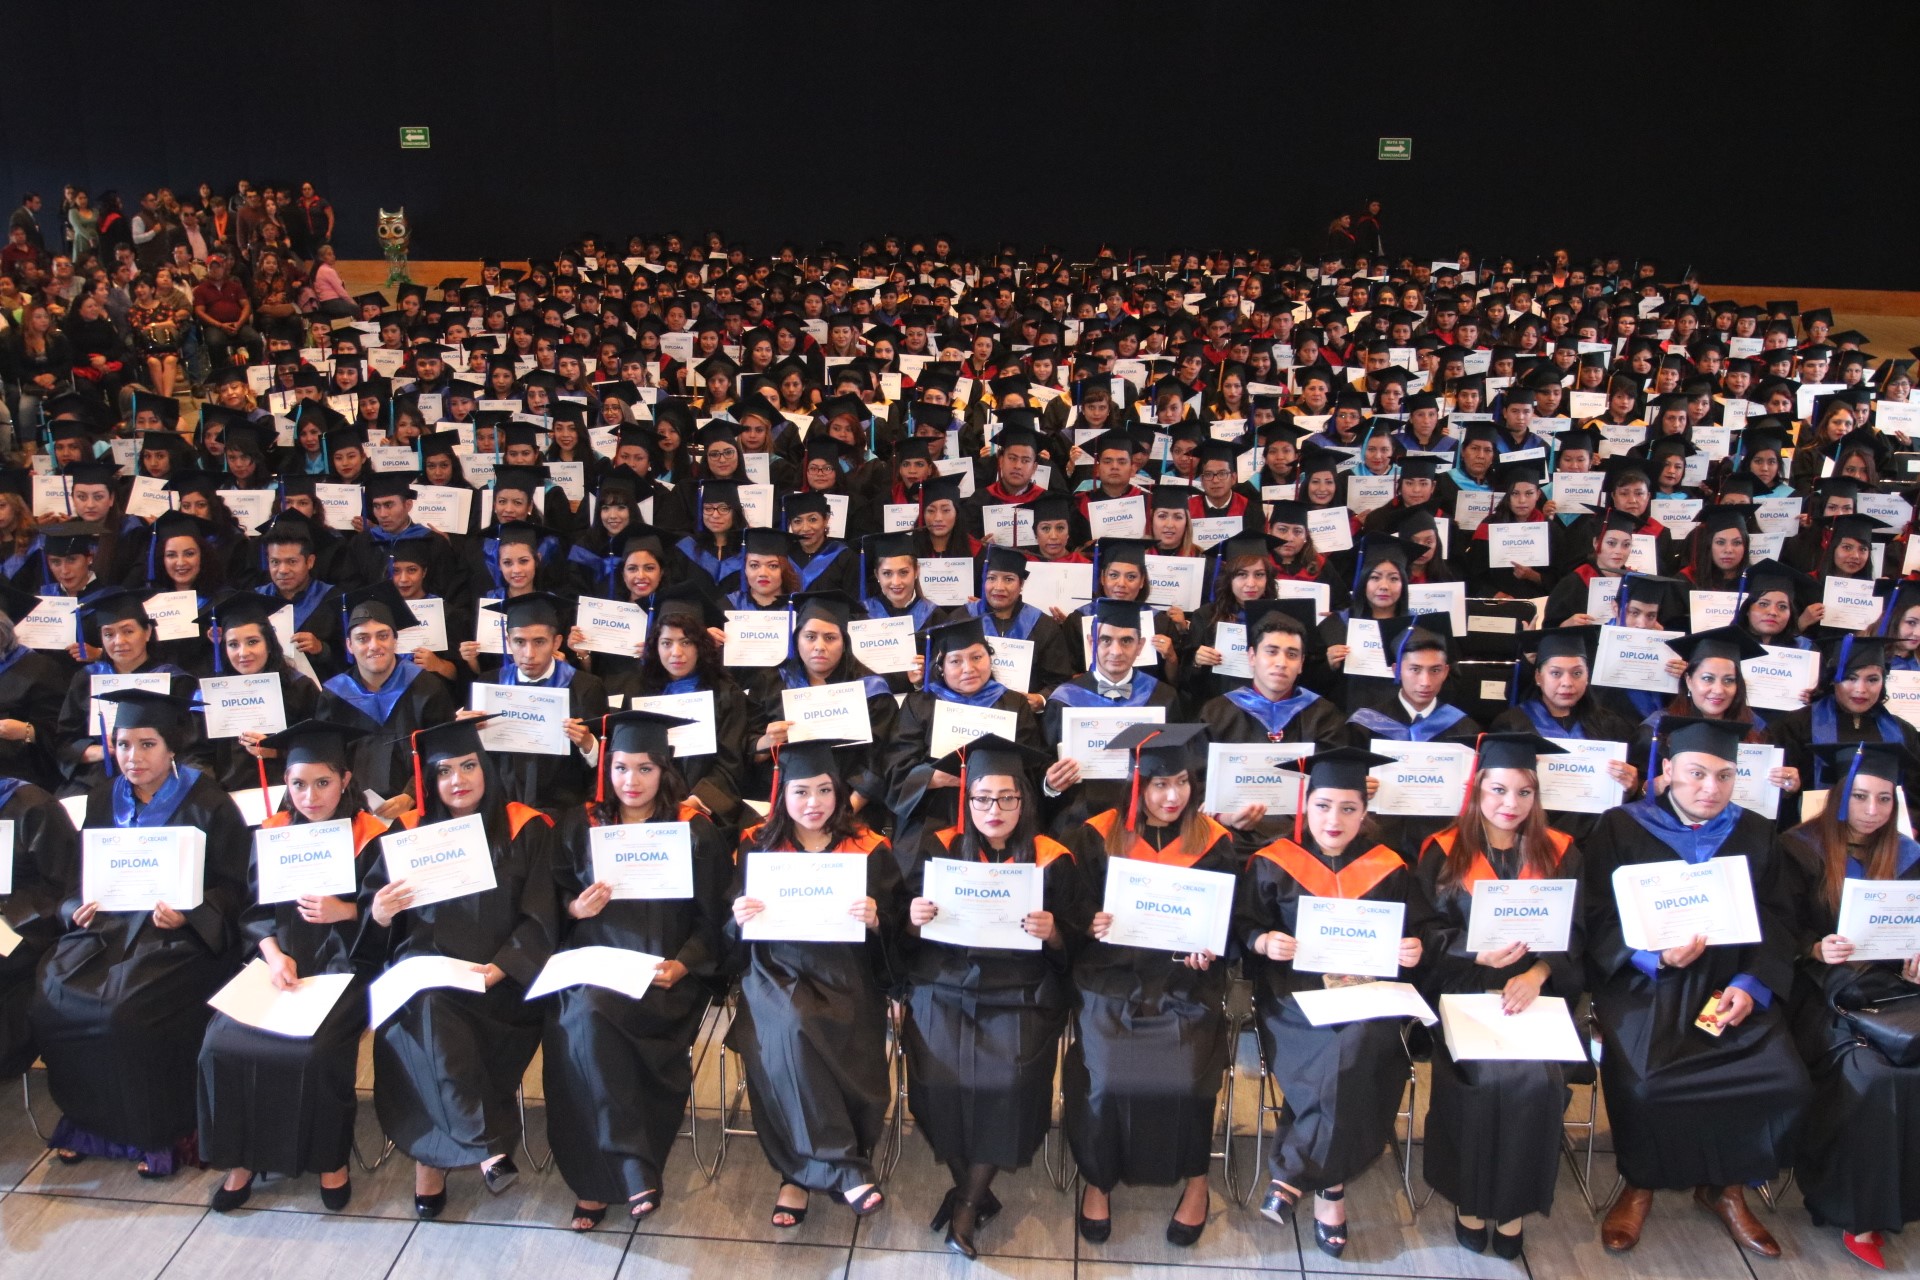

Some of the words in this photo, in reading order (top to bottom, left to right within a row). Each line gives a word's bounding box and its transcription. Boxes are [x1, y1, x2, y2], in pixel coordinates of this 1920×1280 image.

[1838, 596, 1873, 606] DIPLOMA
[740, 631, 780, 640] DIPLOMA
[860, 638, 899, 648] DIPLOMA
[1620, 651, 1659, 661] DIPLOMA
[1751, 666, 1792, 677] DIPLOMA
[221, 697, 265, 707] DIPLOMA
[804, 707, 849, 719] DIPLOMA
[1548, 763, 1595, 774] DIPLOMA
[1235, 775, 1282, 784] DIPLOMA
[1397, 774, 1444, 784] DIPLOMA
[280, 850, 332, 864] DIPLOMA
[410, 848, 466, 868] DIPLOMA
[615, 851, 668, 862] DIPLOMA
[110, 857, 159, 869] DIPLOMA
[779, 887, 834, 897] DIPLOMA
[955, 887, 1011, 898] DIPLOMA
[1654, 894, 1709, 910] DIPLOMA
[1136, 900, 1191, 916] DIPLOMA
[1494, 907, 1549, 916] DIPLOMA
[1320, 926, 1376, 938] DIPLOMA
